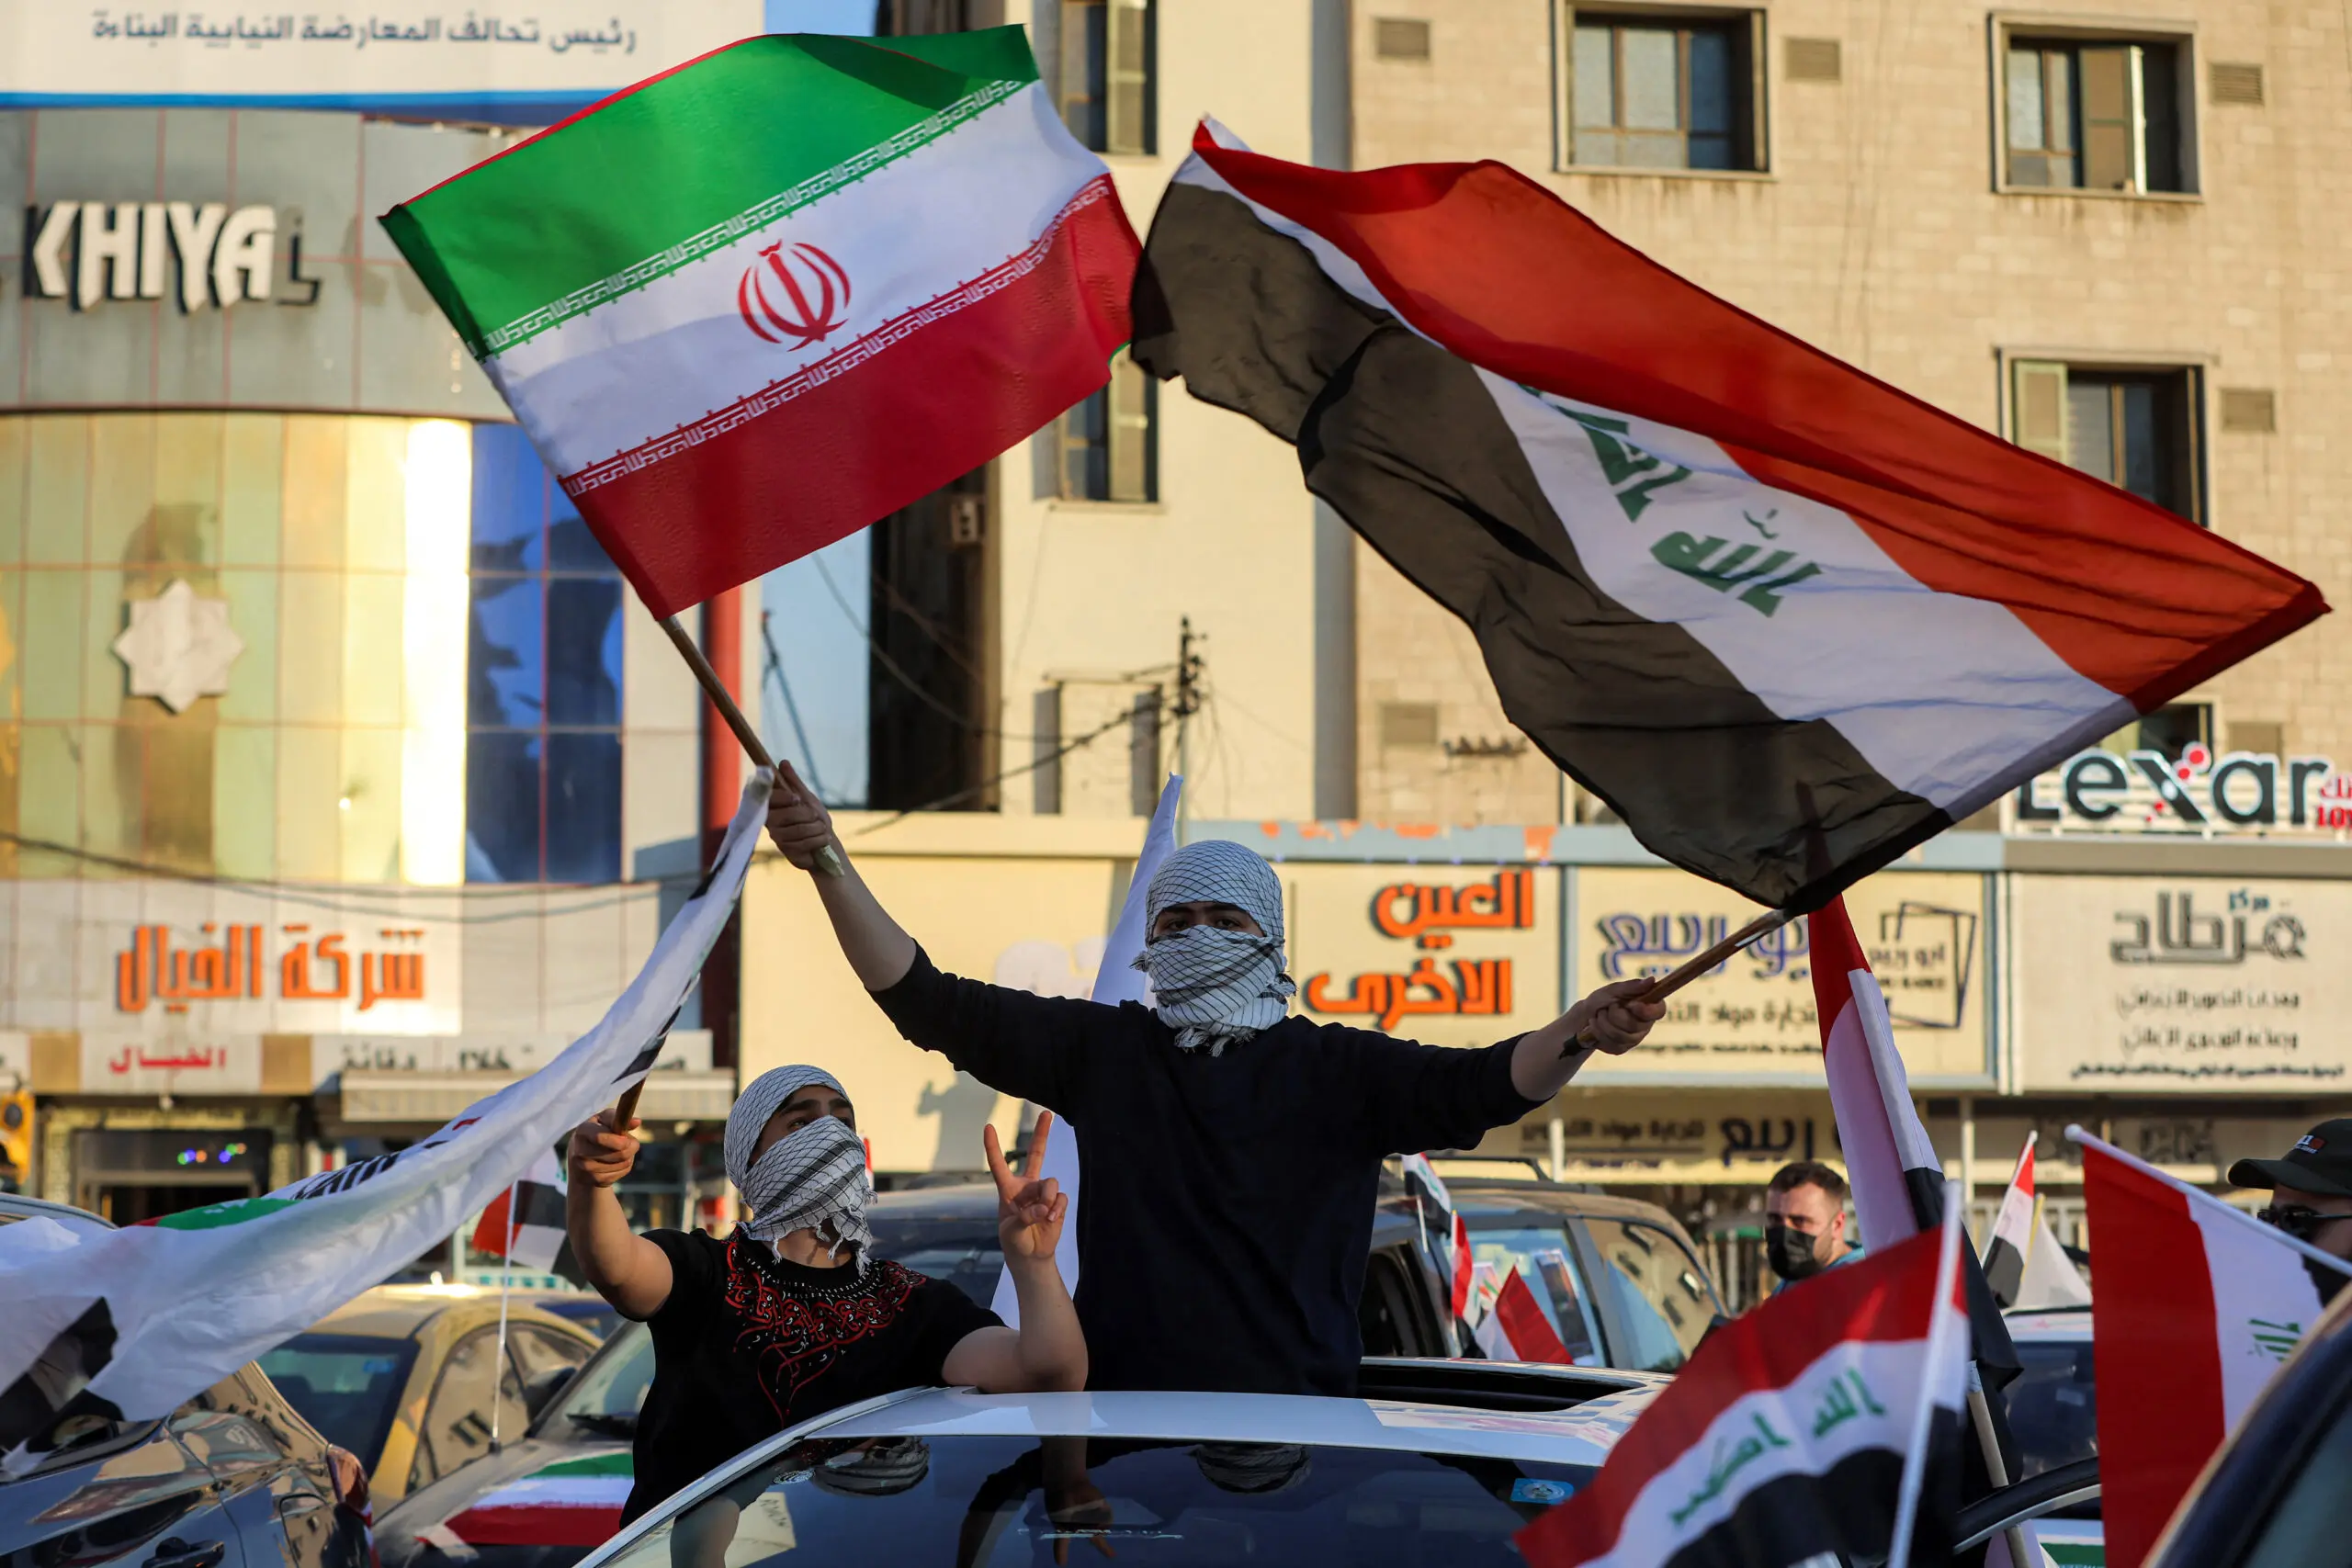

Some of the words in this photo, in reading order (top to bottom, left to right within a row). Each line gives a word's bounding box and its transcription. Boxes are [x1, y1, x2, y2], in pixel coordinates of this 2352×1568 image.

[92, 10, 178, 48] البناءة
[185, 13, 294, 49] النيابية
[300, 15, 441, 50] المعارضة
[447, 9, 539, 41] تحالف
[548, 17, 636, 53] رئيس
[1371, 867, 1533, 950] العين
[116, 922, 264, 1013] الخيال
[279, 922, 424, 1011] شركة
